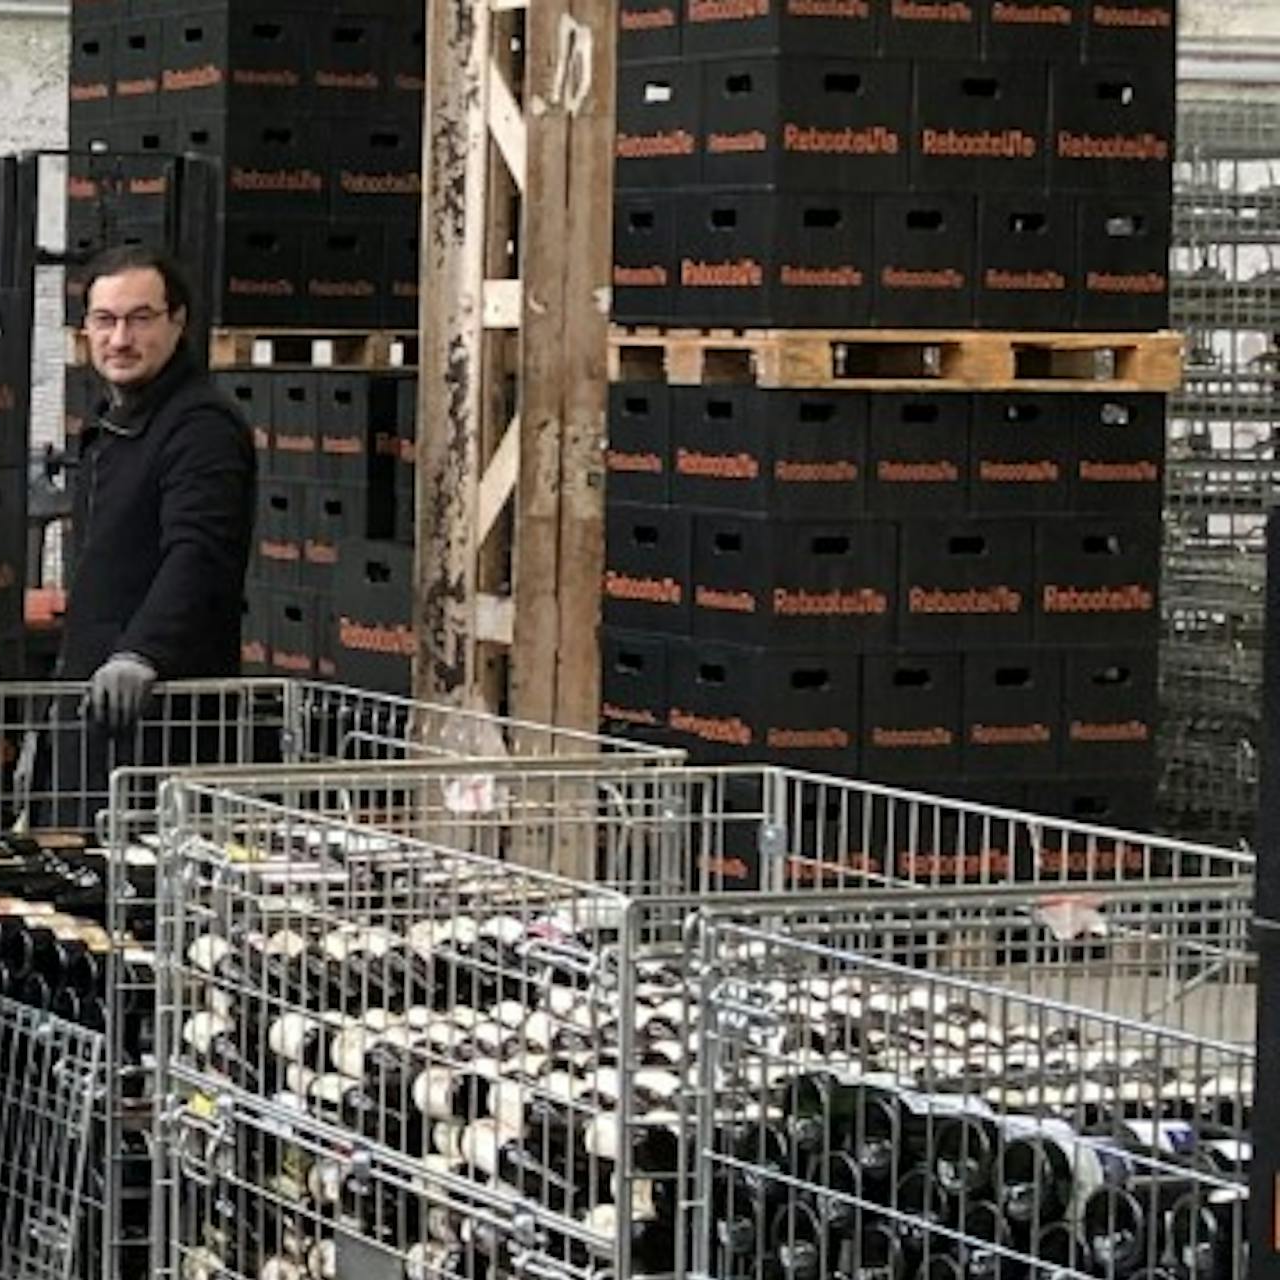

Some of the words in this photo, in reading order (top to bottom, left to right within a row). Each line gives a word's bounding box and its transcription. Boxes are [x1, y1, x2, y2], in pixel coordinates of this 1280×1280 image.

[780, 123, 903, 155] Rebooteille
[916, 128, 1039, 158] Rebooteille
[1053, 132, 1170, 159] Rebooteille
